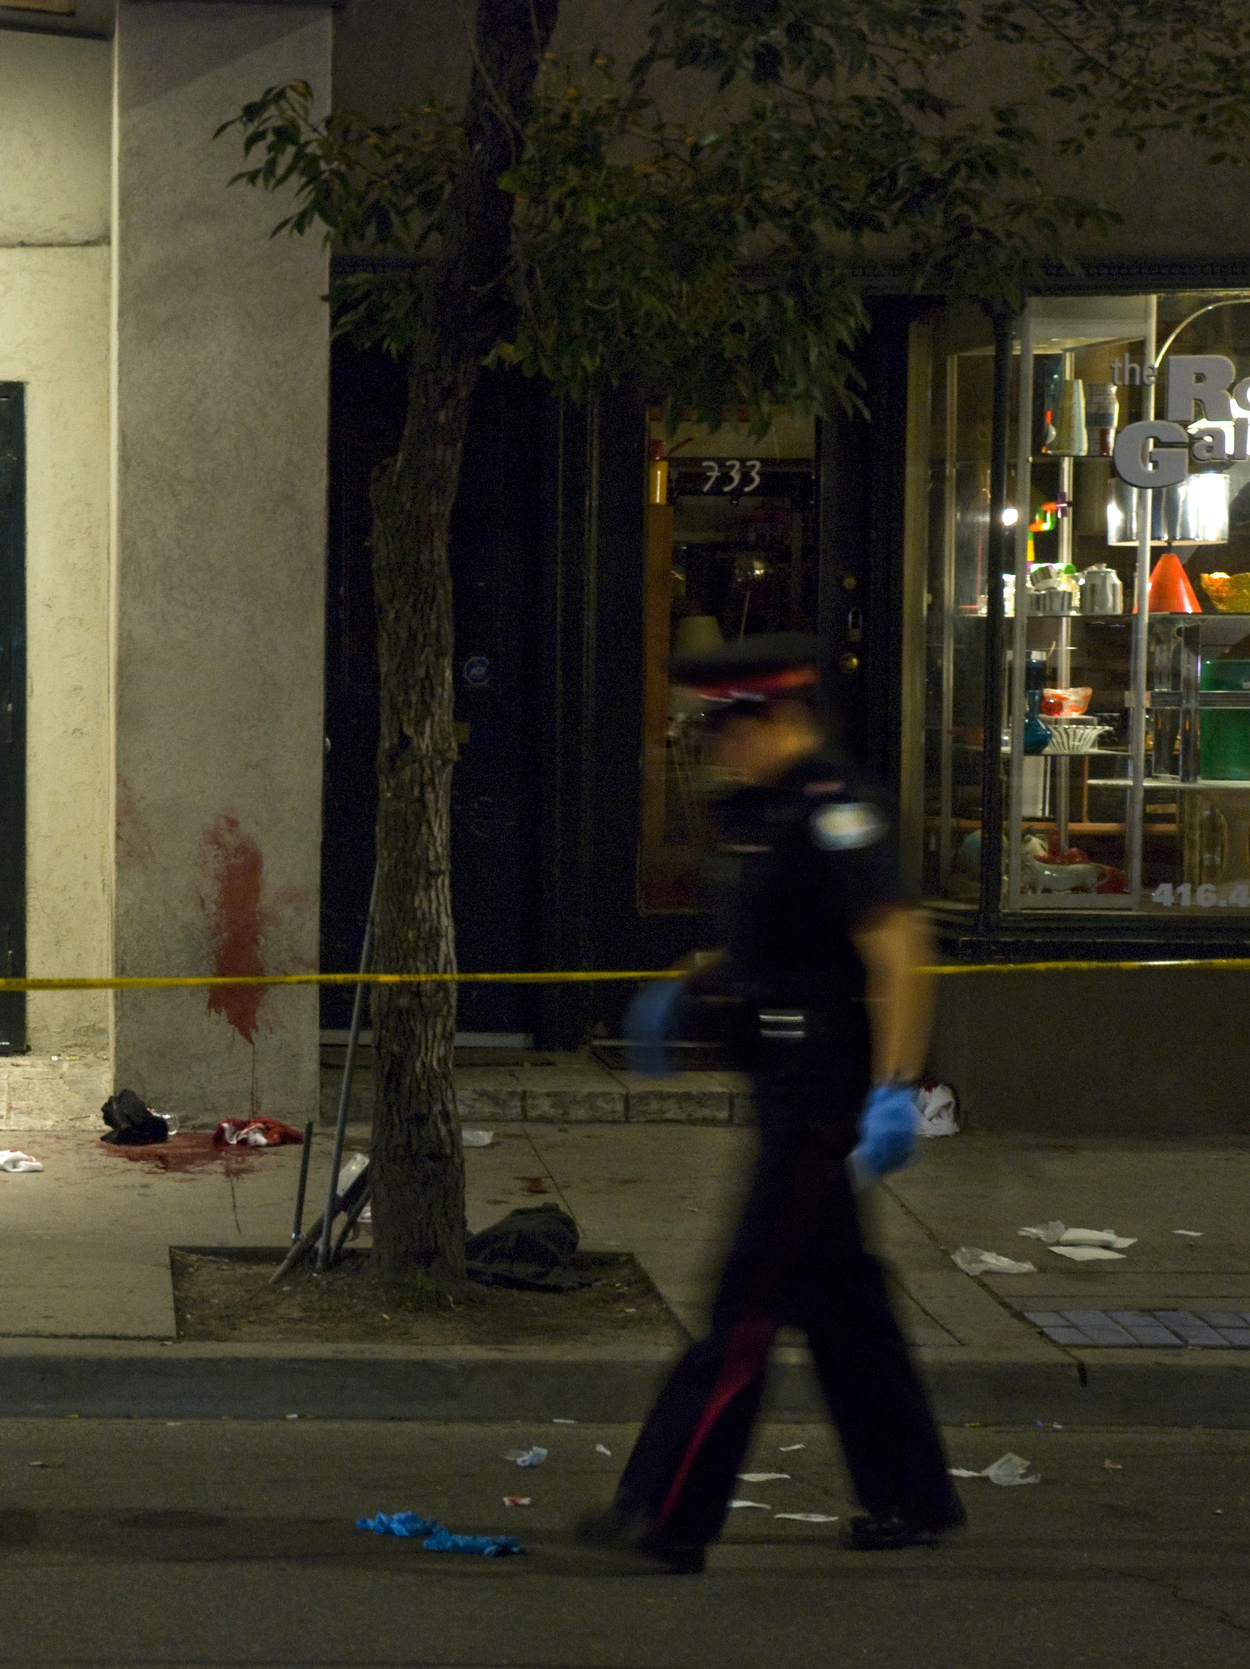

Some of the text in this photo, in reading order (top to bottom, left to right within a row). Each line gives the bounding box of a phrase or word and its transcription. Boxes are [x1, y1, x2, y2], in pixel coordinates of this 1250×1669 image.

[1111, 353, 1158, 386] the
[1114, 417, 1249, 489] Gal
[702, 460, 761, 492] 733
[1152, 883, 1250, 908] 416.4
